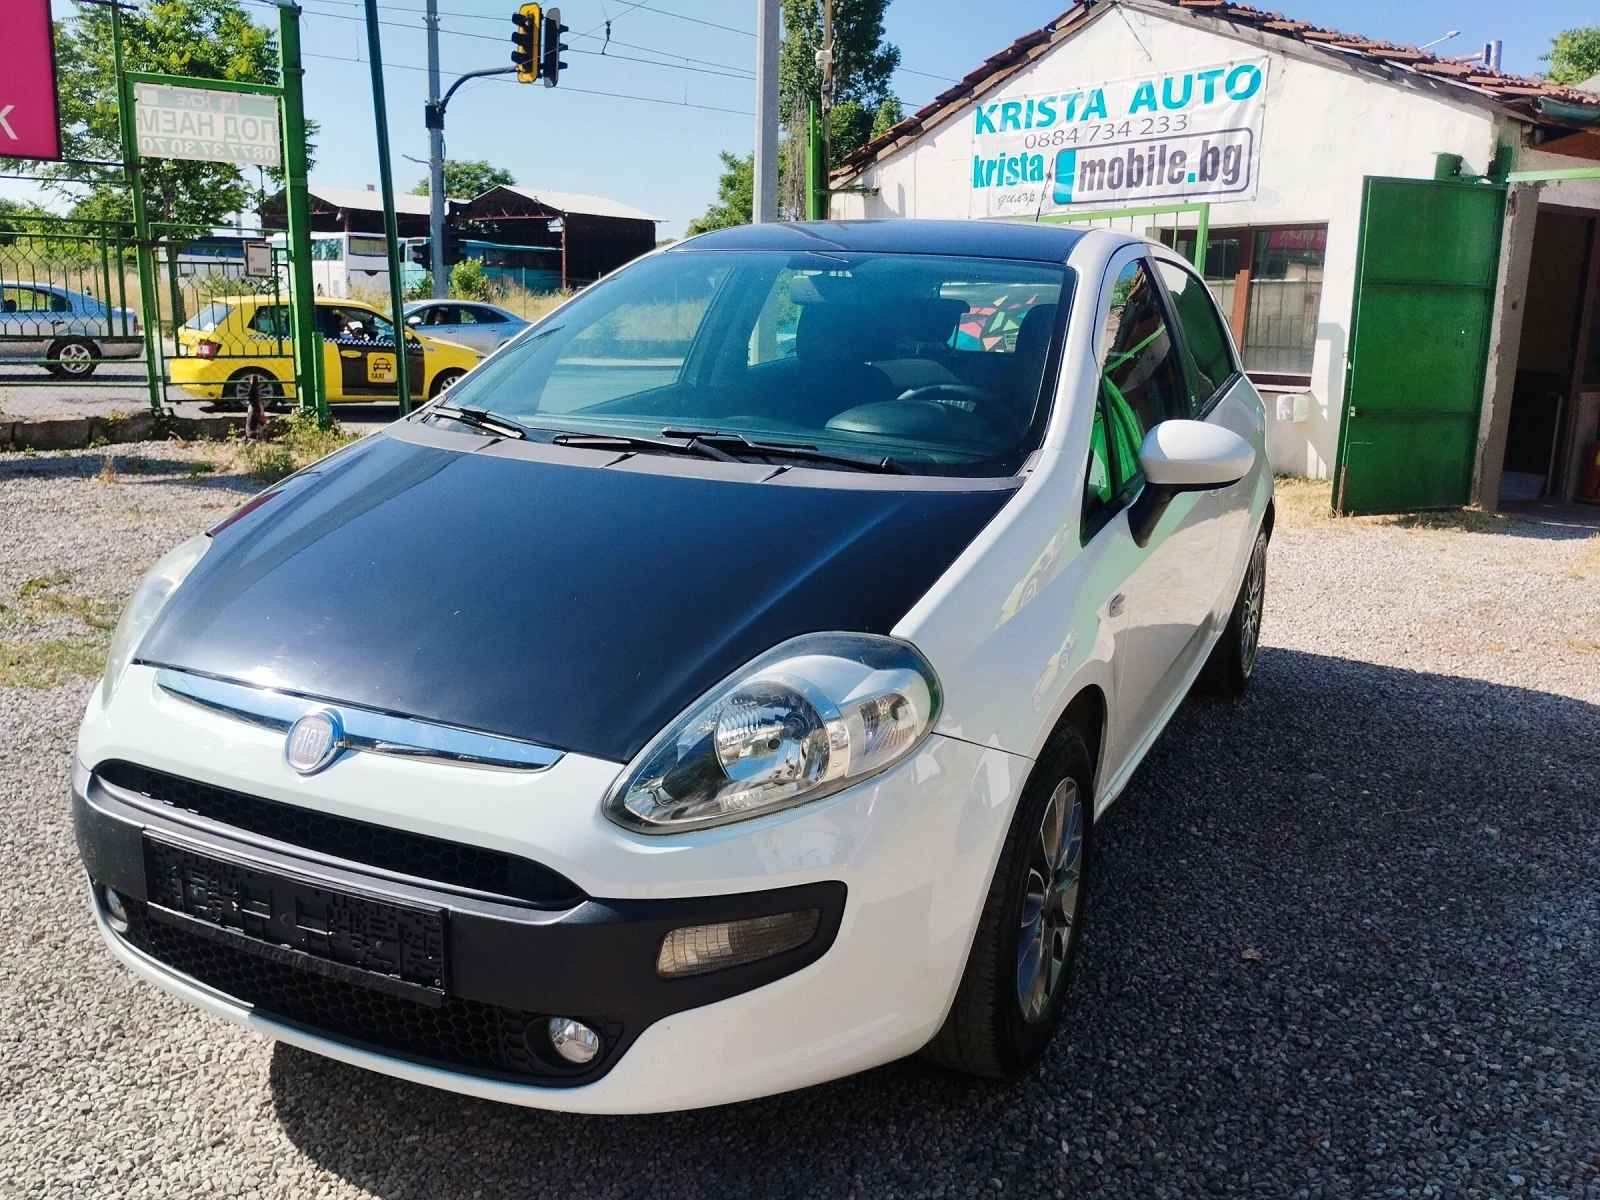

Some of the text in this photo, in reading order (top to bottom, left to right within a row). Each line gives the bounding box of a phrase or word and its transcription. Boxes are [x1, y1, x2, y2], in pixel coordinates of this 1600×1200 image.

[975, 64, 1262, 135] KRISTA AUTO
[1024, 114, 1188, 149] 0884 734 233
[973, 151, 1044, 188] krista
[1077, 140, 1243, 193] mobile.bg
[293, 726, 328, 758] FIAT
